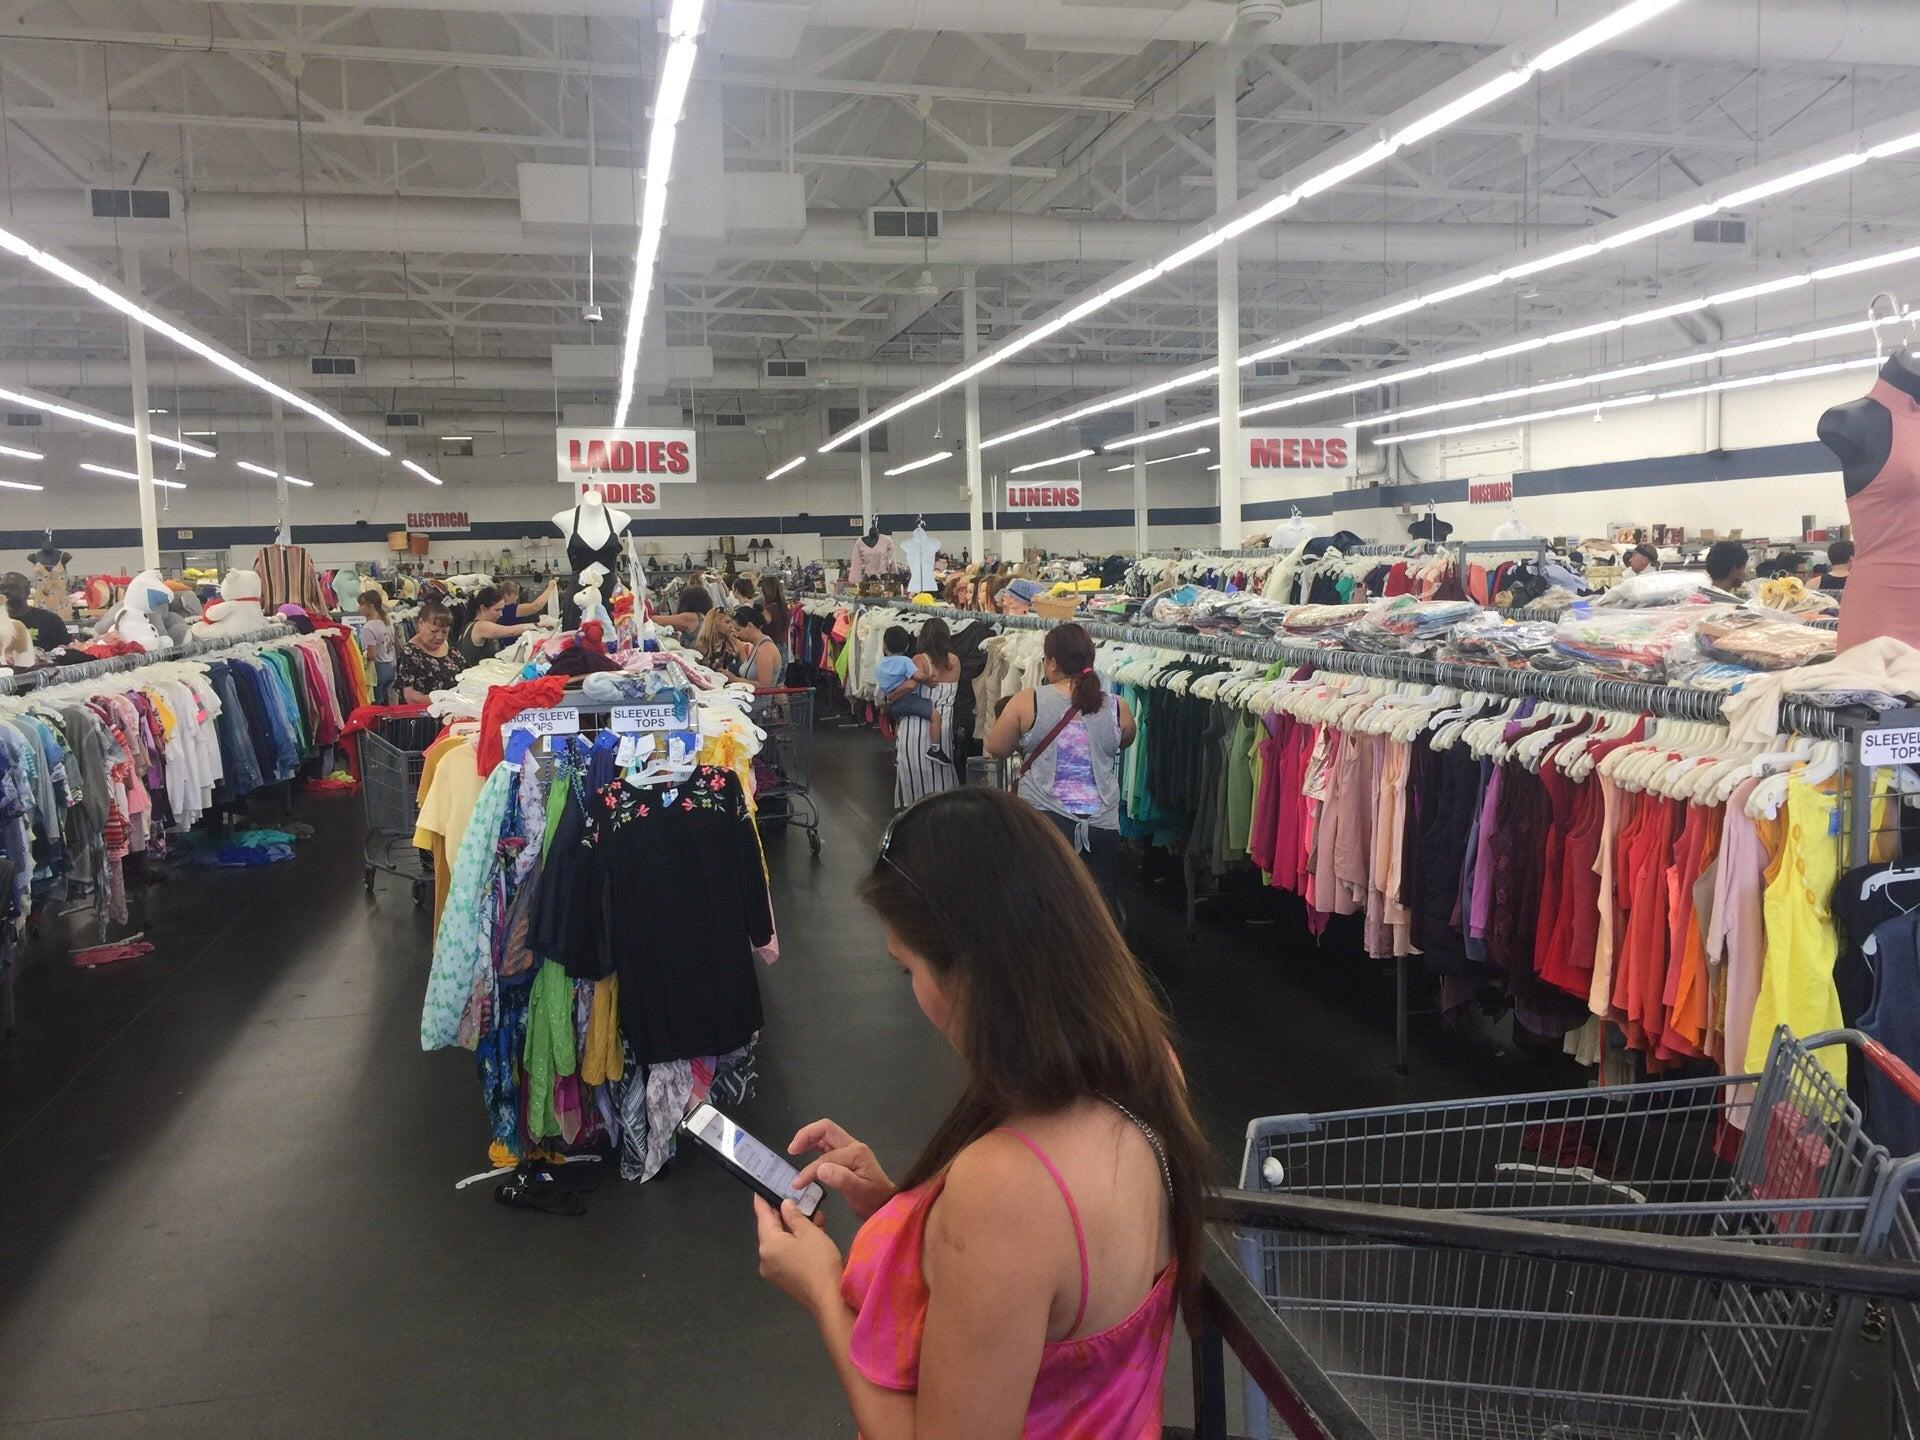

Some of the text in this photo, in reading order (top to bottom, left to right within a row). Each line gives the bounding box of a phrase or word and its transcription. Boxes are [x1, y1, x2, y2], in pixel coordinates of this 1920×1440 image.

[569, 439, 689, 474] LADIES
[1250, 438, 1347, 468] MENS
[1008, 487, 1080, 507] LINENS
[407, 512, 469, 527] ELECTRICAL
[508, 711, 576, 723] HORT SLEEVE
[636, 719, 665, 727] TOPS
[533, 722, 553, 731] OPS
